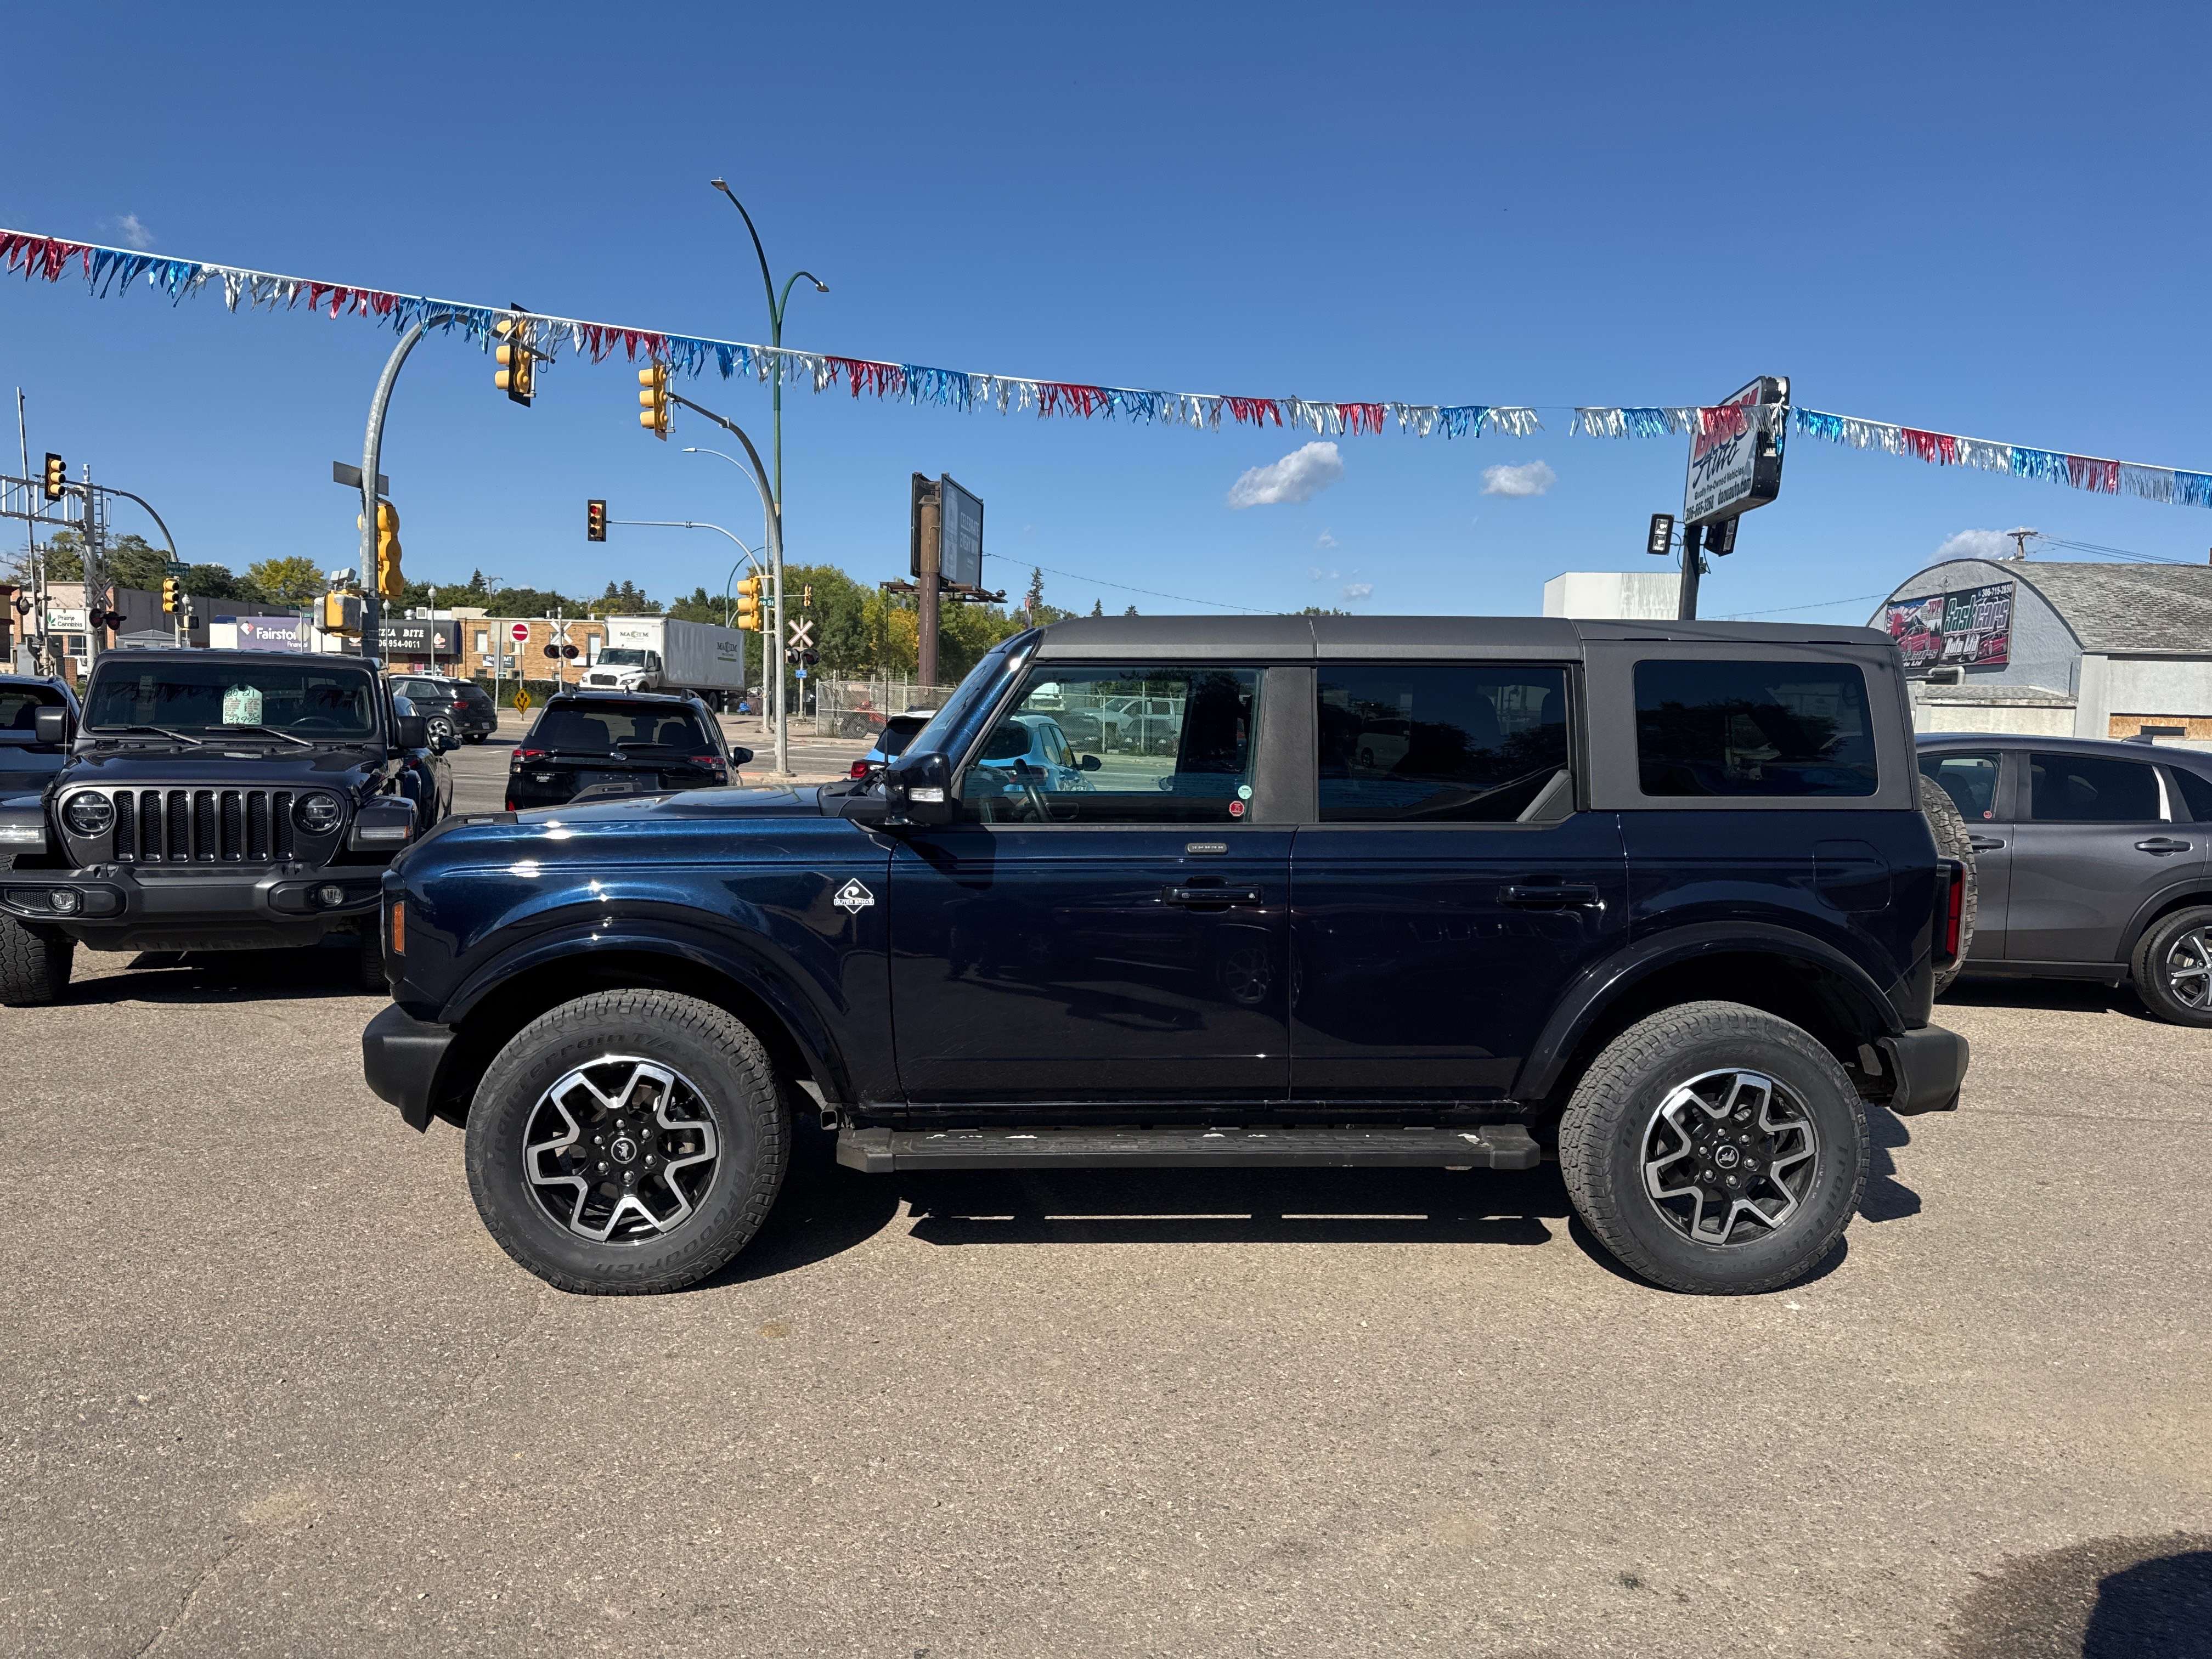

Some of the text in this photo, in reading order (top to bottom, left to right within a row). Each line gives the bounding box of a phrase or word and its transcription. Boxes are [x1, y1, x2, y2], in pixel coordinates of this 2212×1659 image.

[1692, 441, 1740, 489] Auto
[403, 629, 424, 637] BITE
[1945, 633, 1980, 656] Auto Ltd
